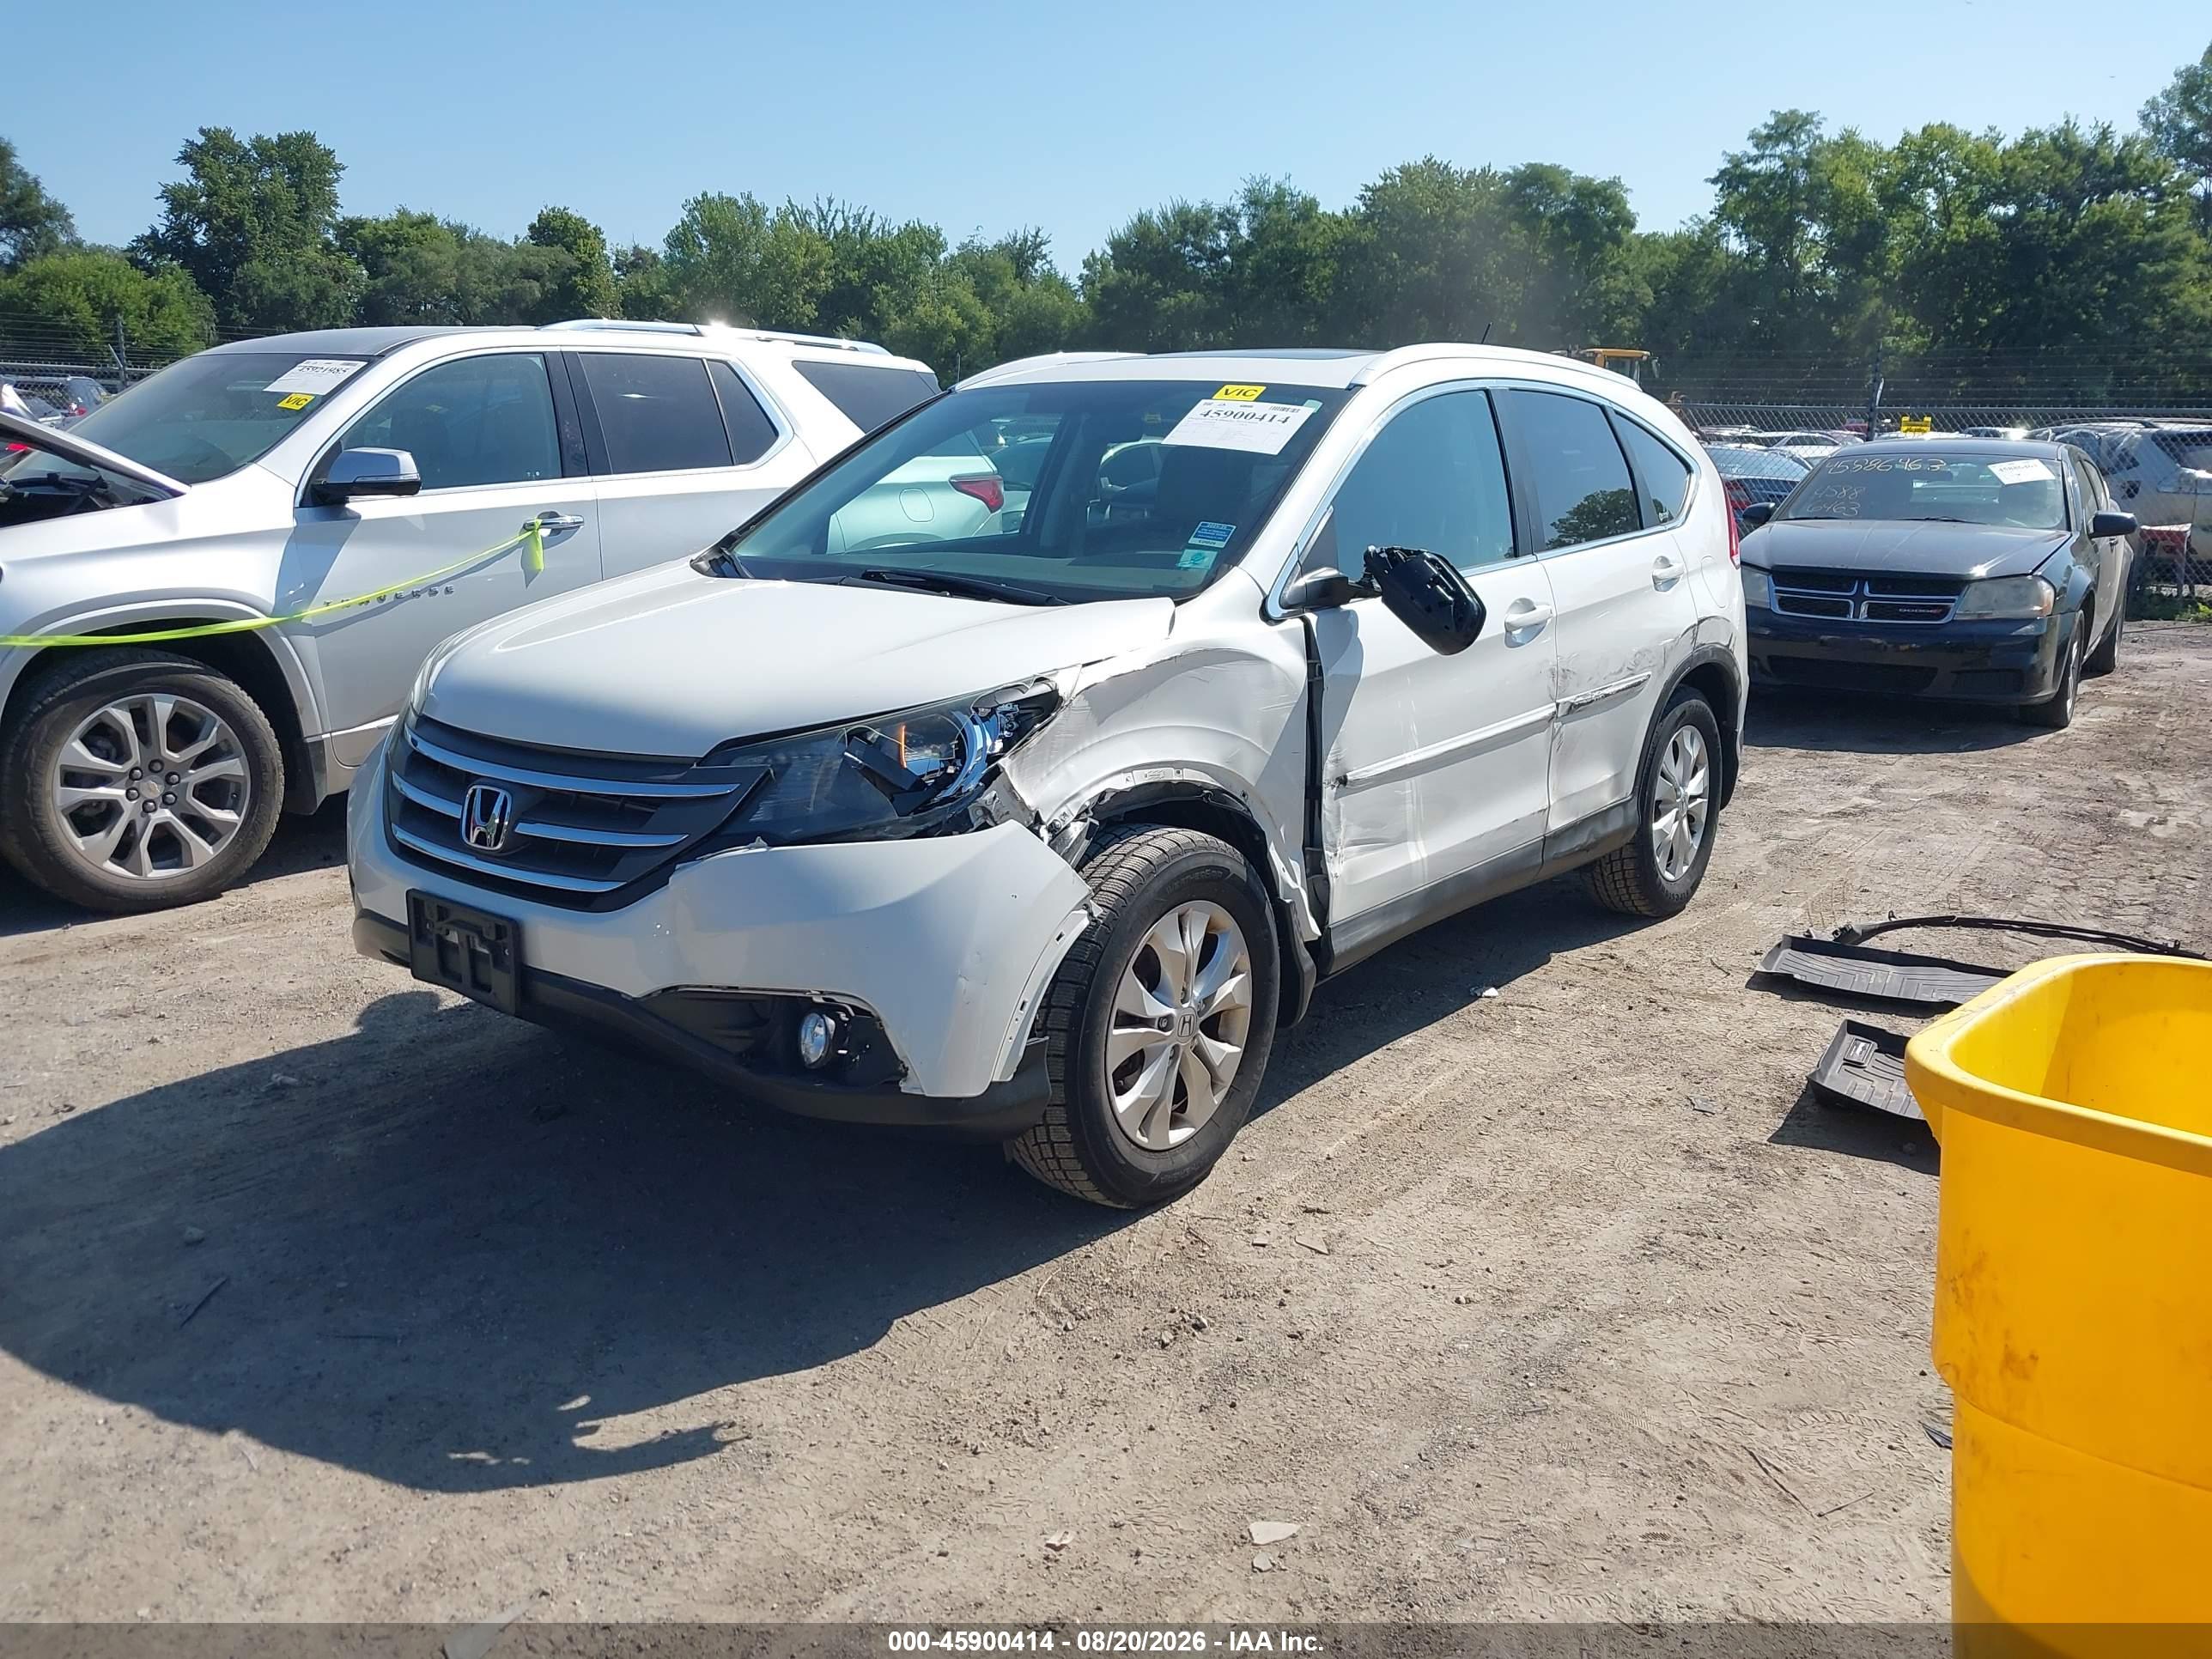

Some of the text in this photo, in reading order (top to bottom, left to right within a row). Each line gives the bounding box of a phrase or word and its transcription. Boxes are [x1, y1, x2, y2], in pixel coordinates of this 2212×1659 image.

[1224, 388, 1259, 398] VIC
[285, 396, 308, 406] VIC
[1200, 409, 1291, 424] 45900414
